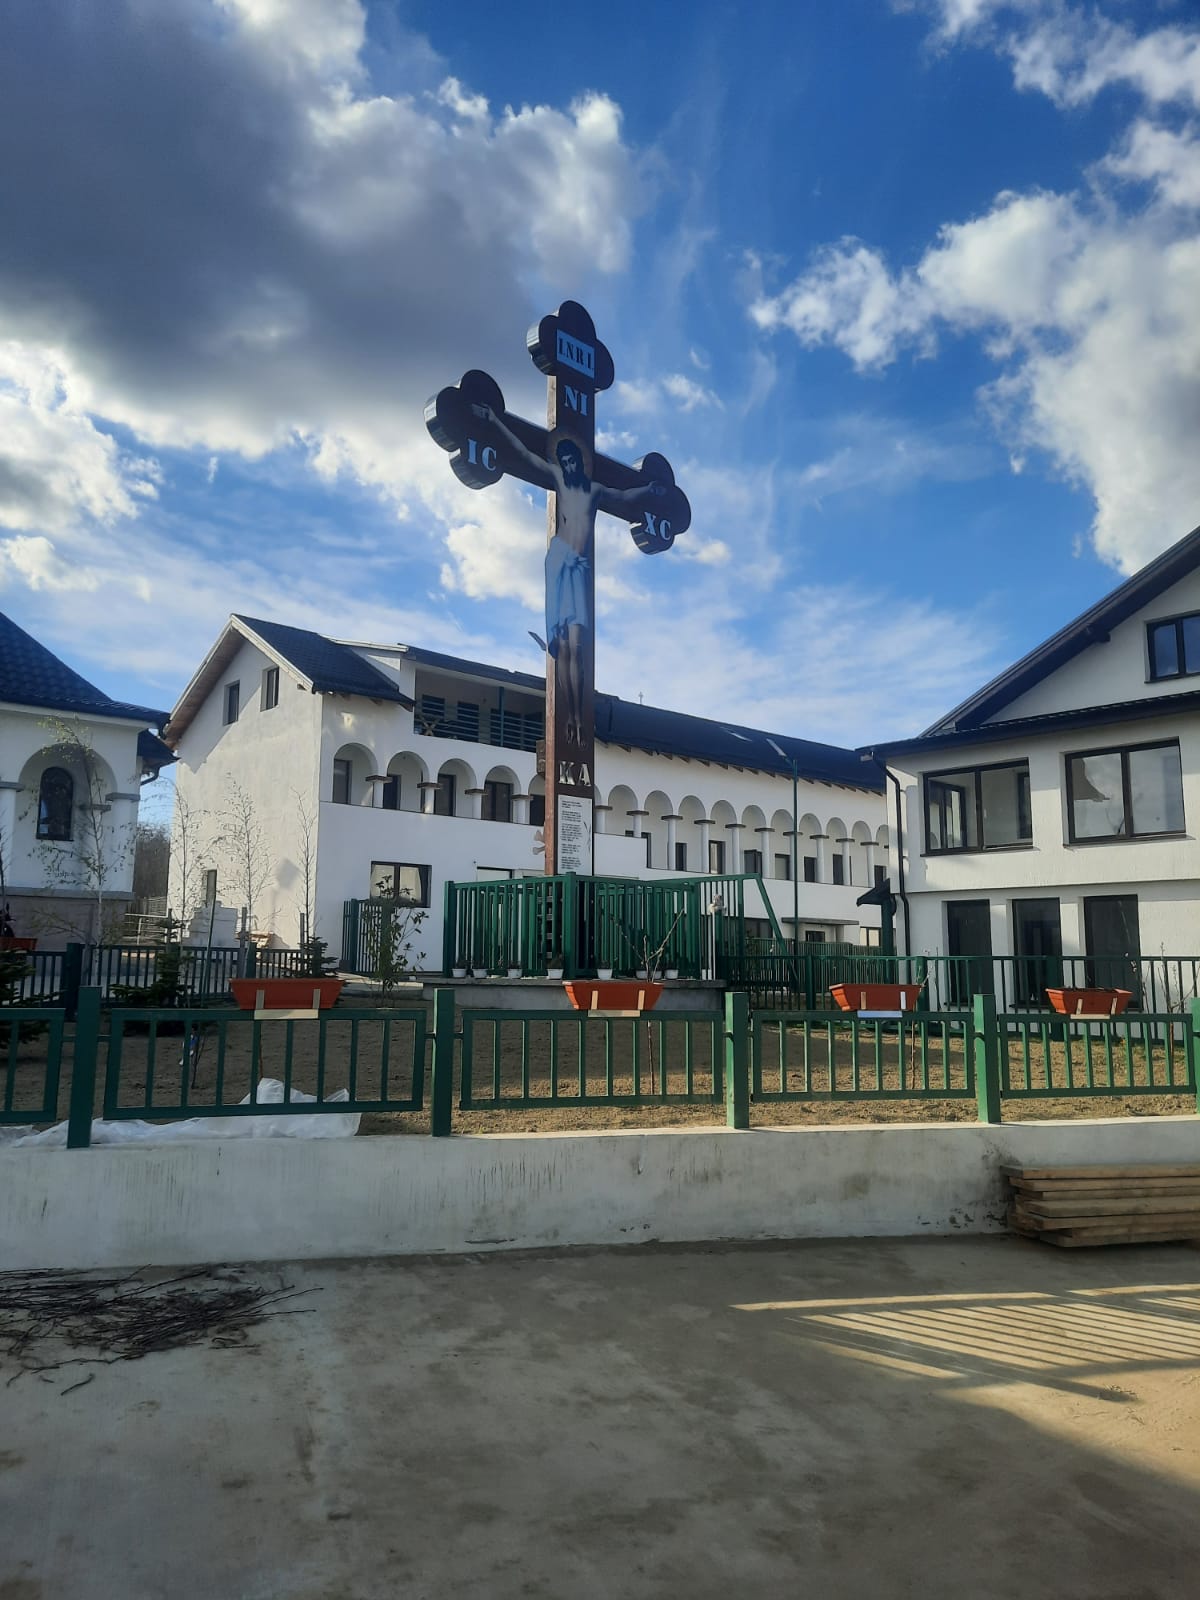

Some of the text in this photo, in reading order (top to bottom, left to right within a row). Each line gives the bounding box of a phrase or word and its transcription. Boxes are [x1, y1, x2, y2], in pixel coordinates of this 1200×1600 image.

[564, 384, 588, 416] NI
[467, 438, 497, 472] IC
[644, 511, 671, 541] XC
[559, 761, 592, 787] KA
